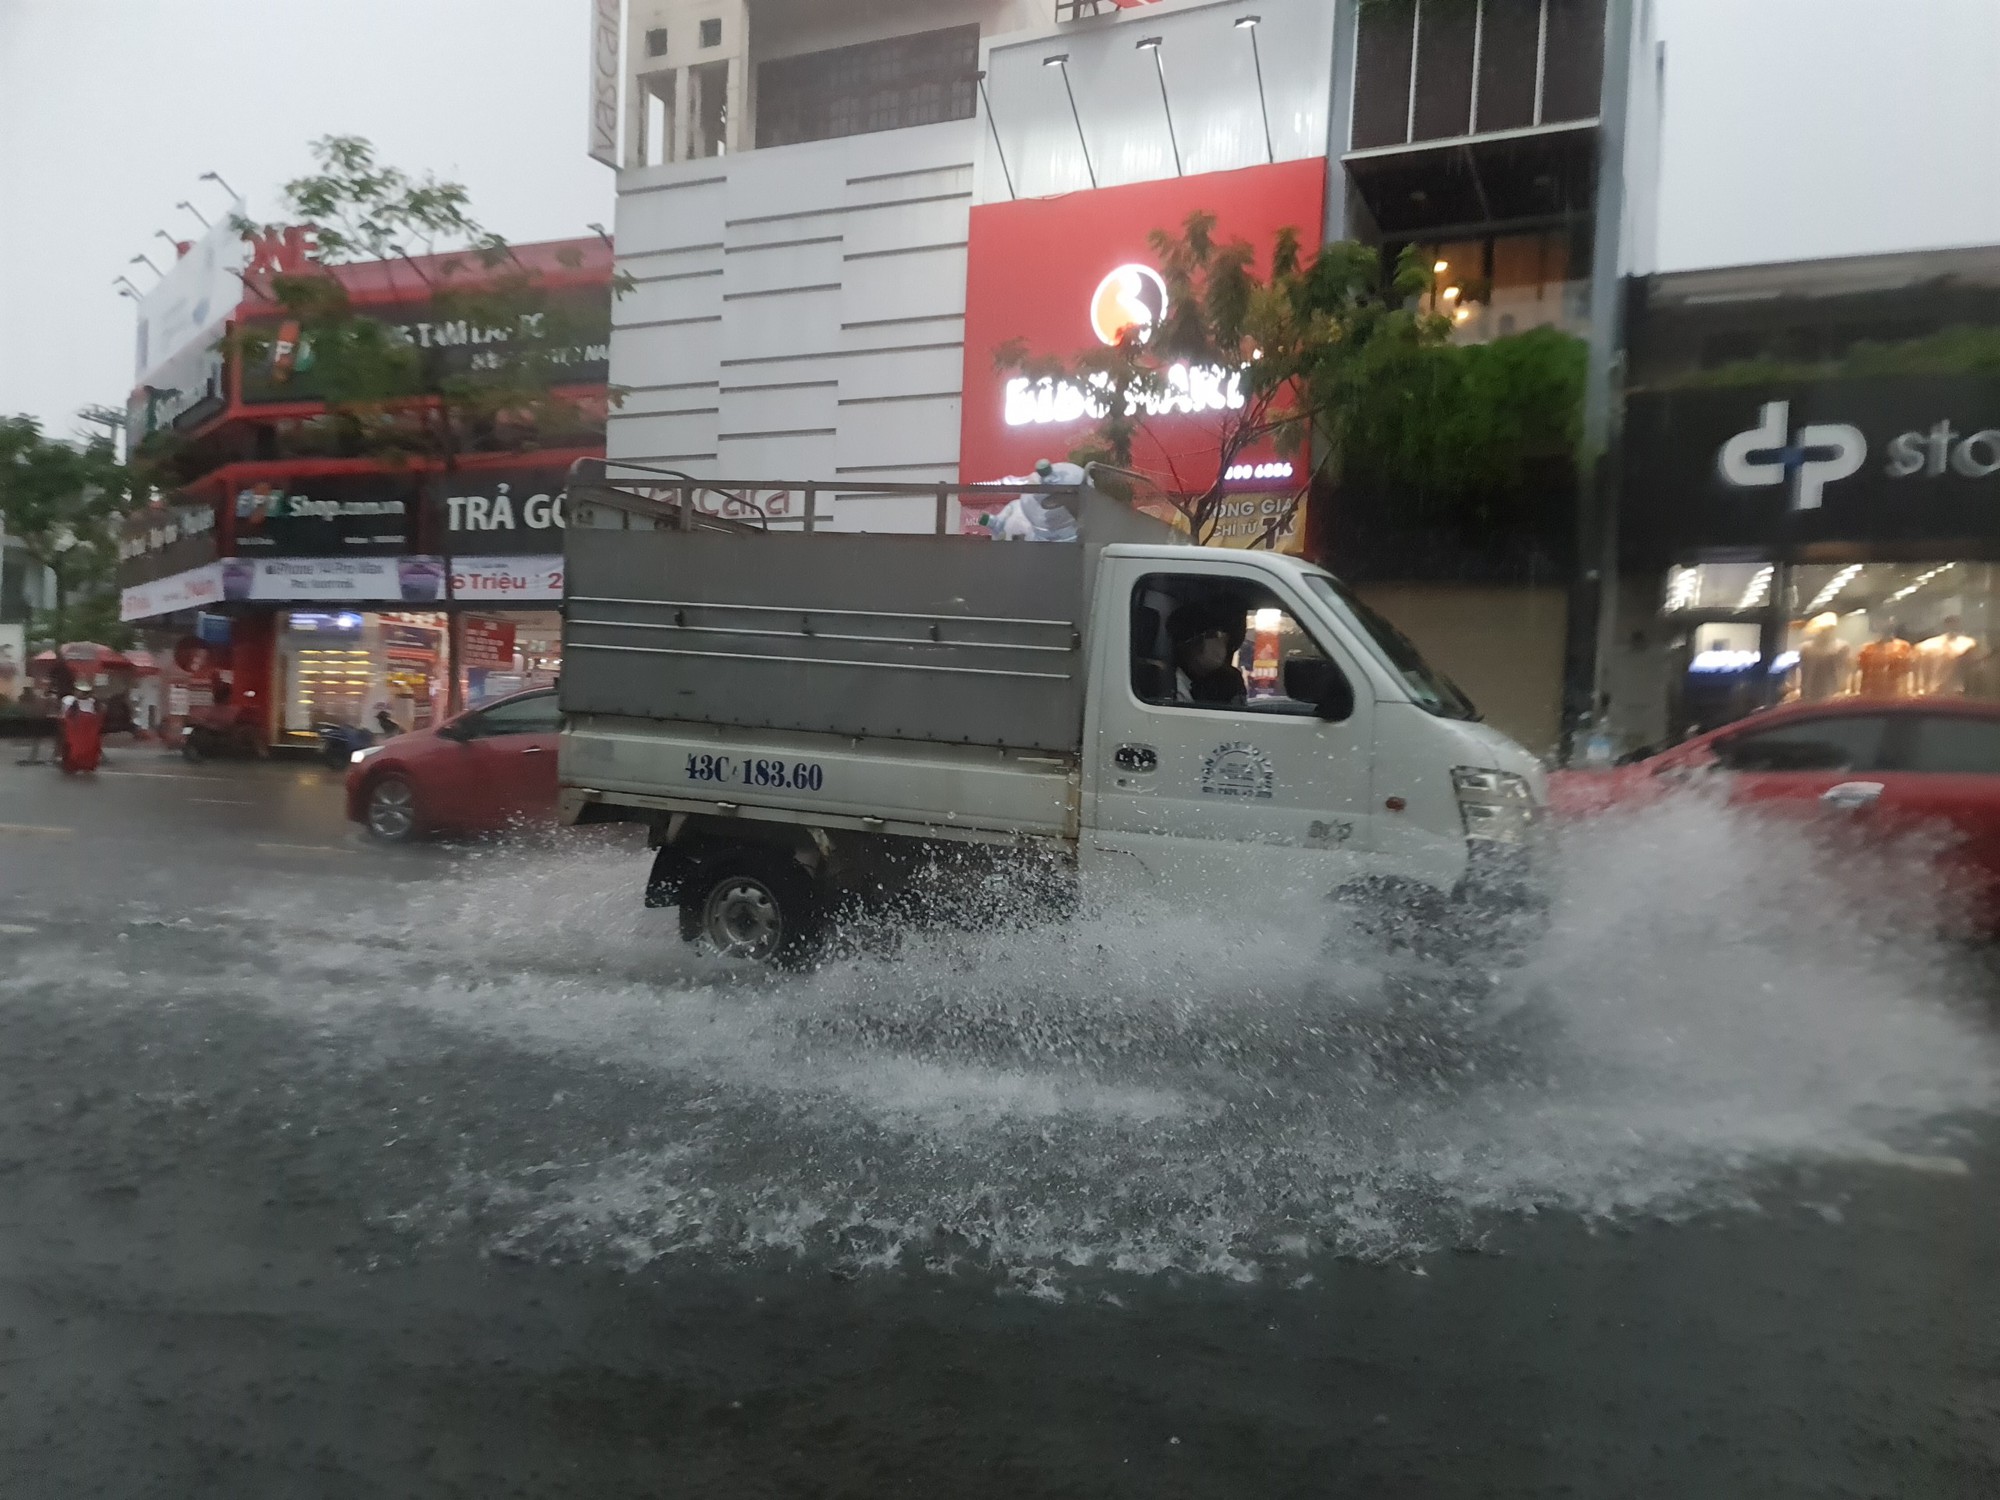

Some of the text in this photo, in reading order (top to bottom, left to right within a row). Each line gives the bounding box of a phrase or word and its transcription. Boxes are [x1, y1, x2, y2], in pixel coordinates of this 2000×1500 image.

[447, 482, 515, 532] TRẢ
[468, 571, 527, 594] Triệu
[685, 752, 823, 791] 43C 183.60
